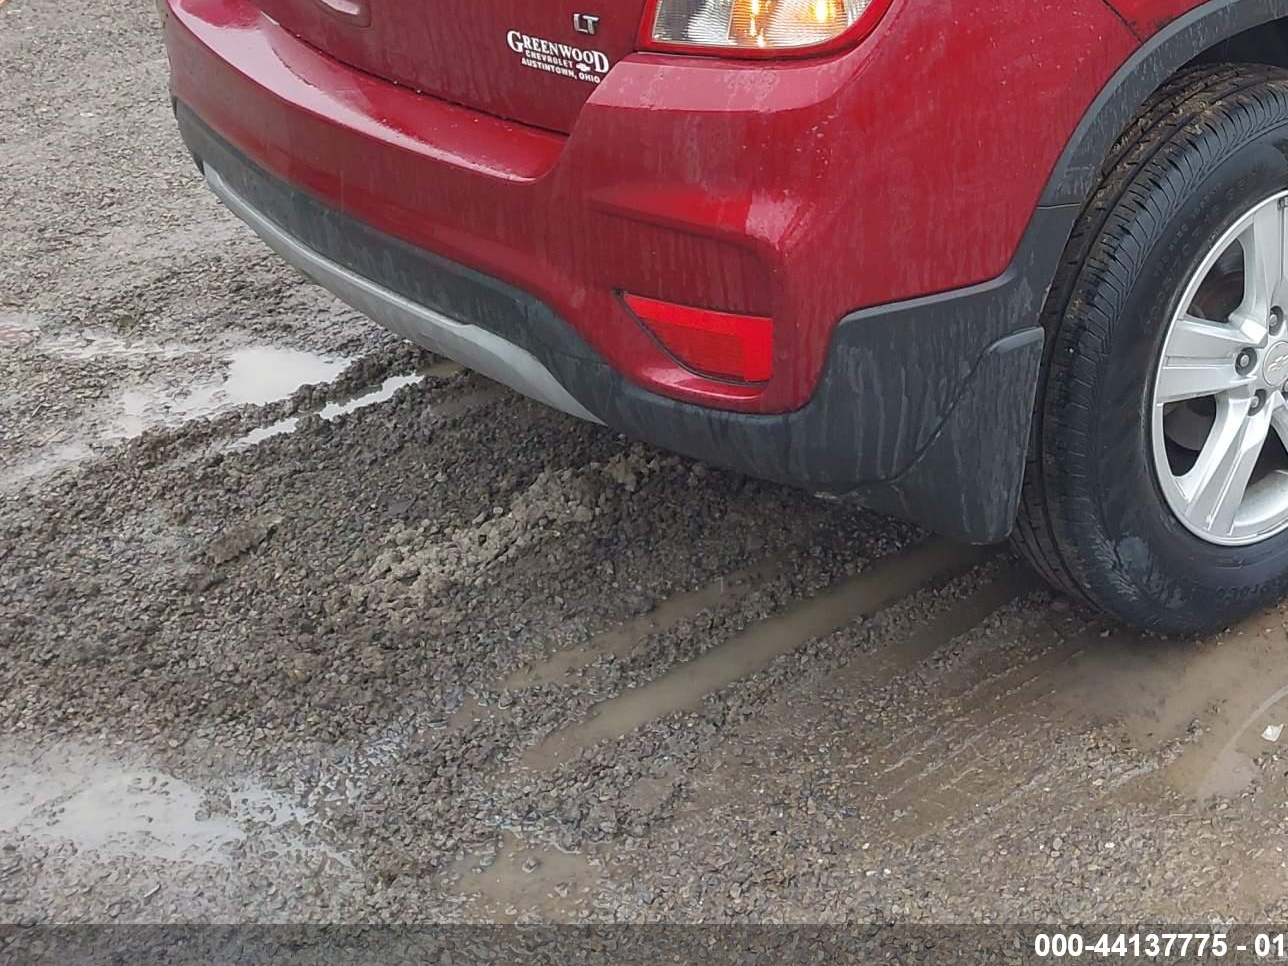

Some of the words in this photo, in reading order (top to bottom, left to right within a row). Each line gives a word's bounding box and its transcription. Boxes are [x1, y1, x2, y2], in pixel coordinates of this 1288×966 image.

[573, 13, 599, 34] LT
[507, 30, 609, 73] GREENWOOD
[525, 49, 573, 68] CHEVROLET
[521, 57, 578, 80] AUSTINTOWN,
[579, 71, 601, 84] OHIO
